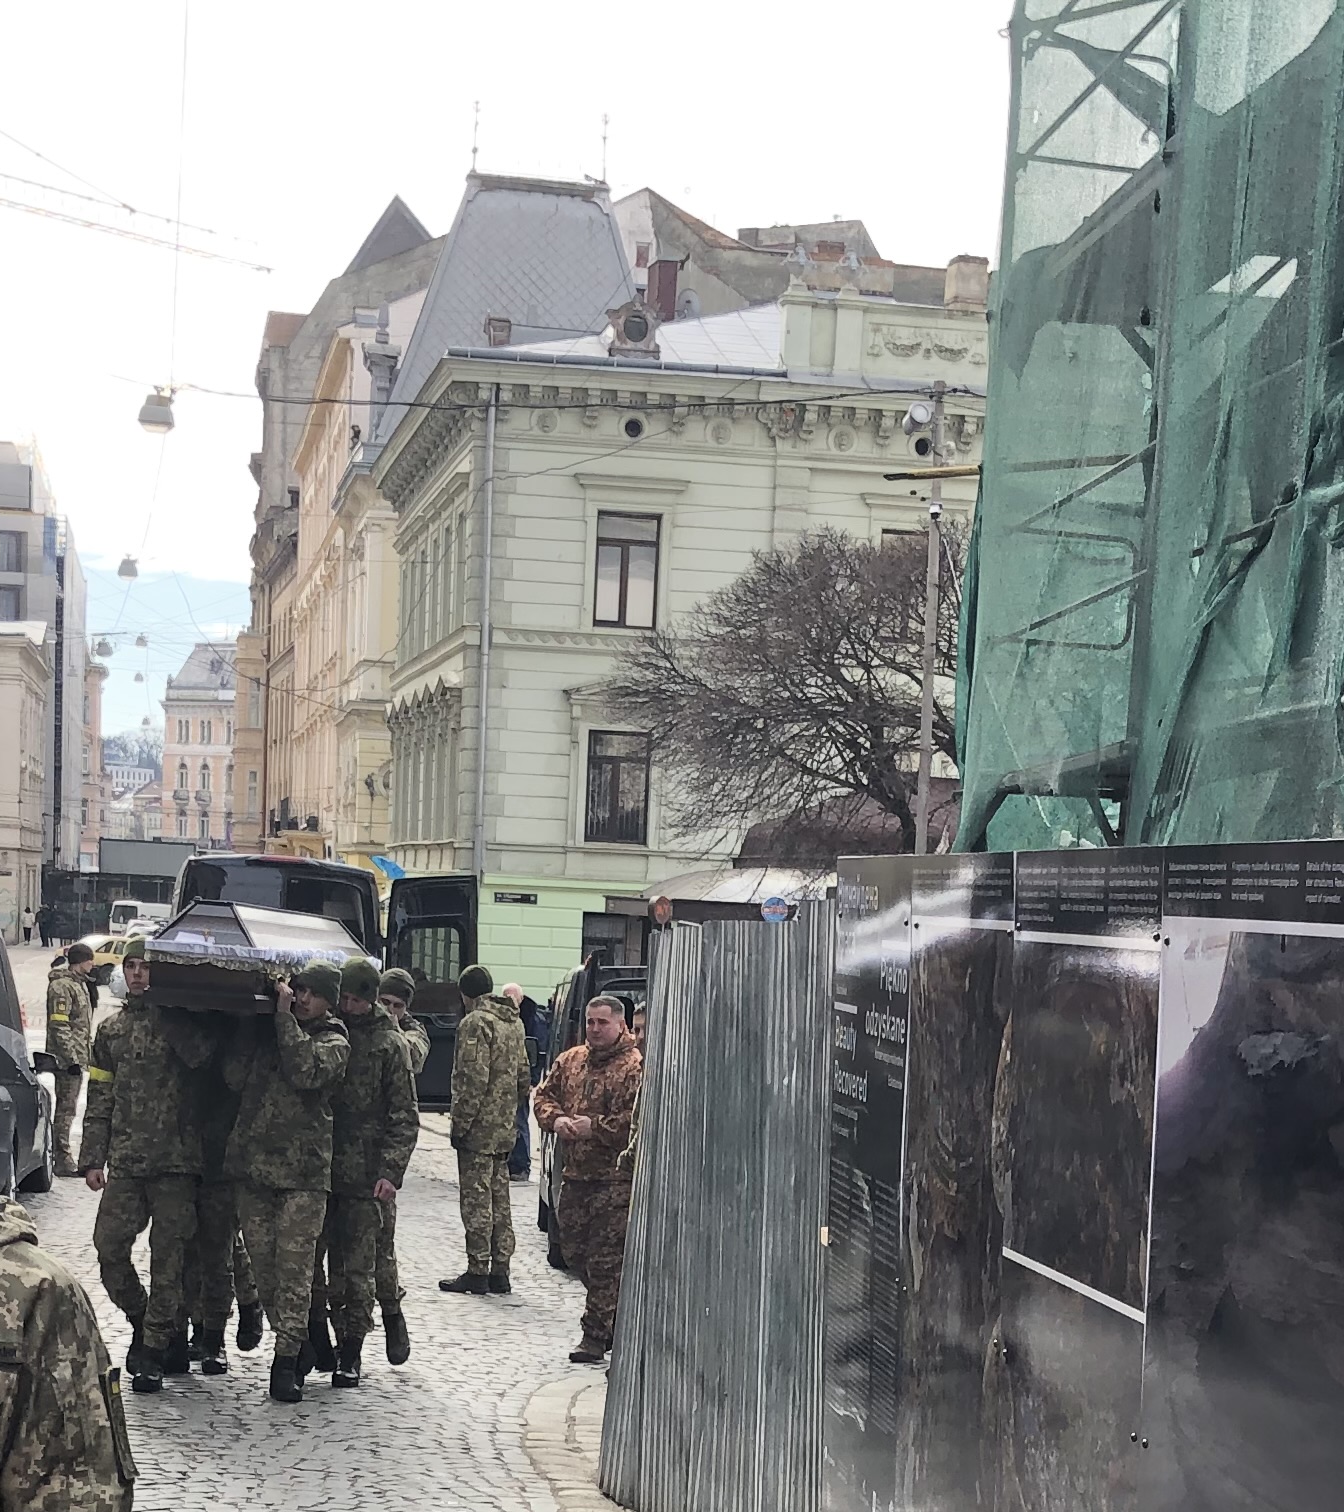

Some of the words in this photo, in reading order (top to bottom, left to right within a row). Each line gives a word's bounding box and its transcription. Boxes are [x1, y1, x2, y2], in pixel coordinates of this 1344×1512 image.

[880, 957, 908, 1000] Piękno
[835, 1016, 857, 1061] Beauty
[865, 1002, 906, 1046] odzyskane
[833, 1059, 868, 1103] Recovered
